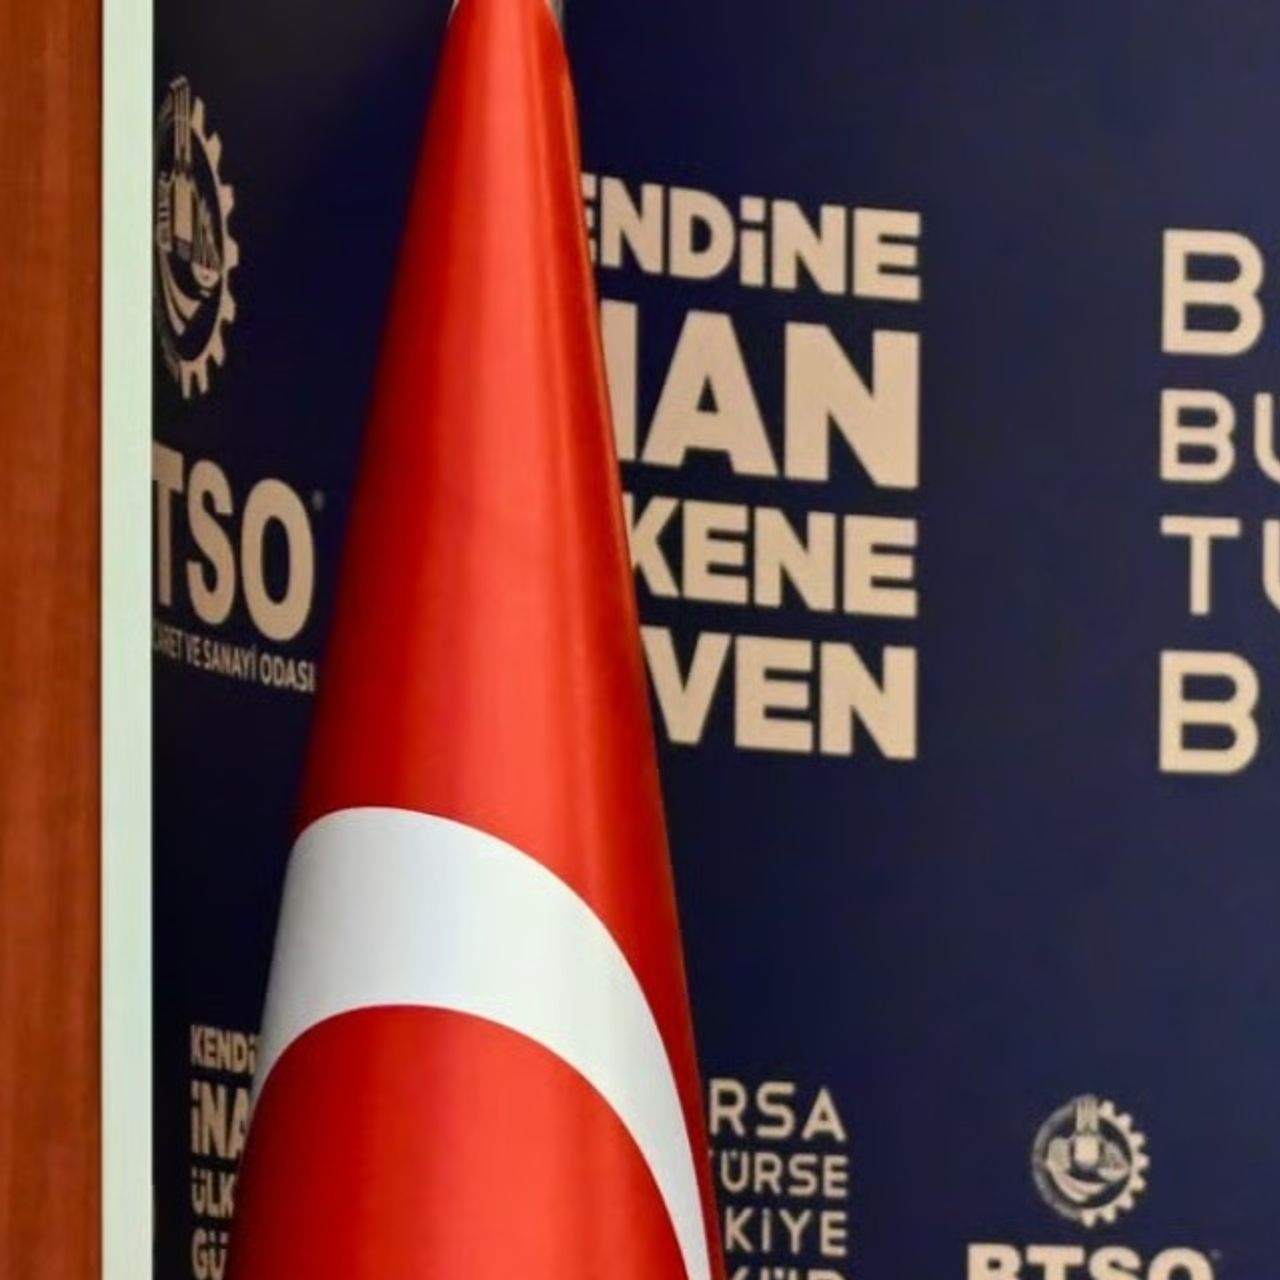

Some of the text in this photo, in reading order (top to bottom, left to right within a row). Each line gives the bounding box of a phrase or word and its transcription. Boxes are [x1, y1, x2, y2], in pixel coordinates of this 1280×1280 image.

[583, 173, 921, 301] NDİNE
[152, 440, 315, 642] TSO
[260, 651, 316, 694] ODASI
[639, 626, 917, 760] VEN
[708, 1078, 847, 1142] RSA
[724, 1206, 848, 1257] KİYE
